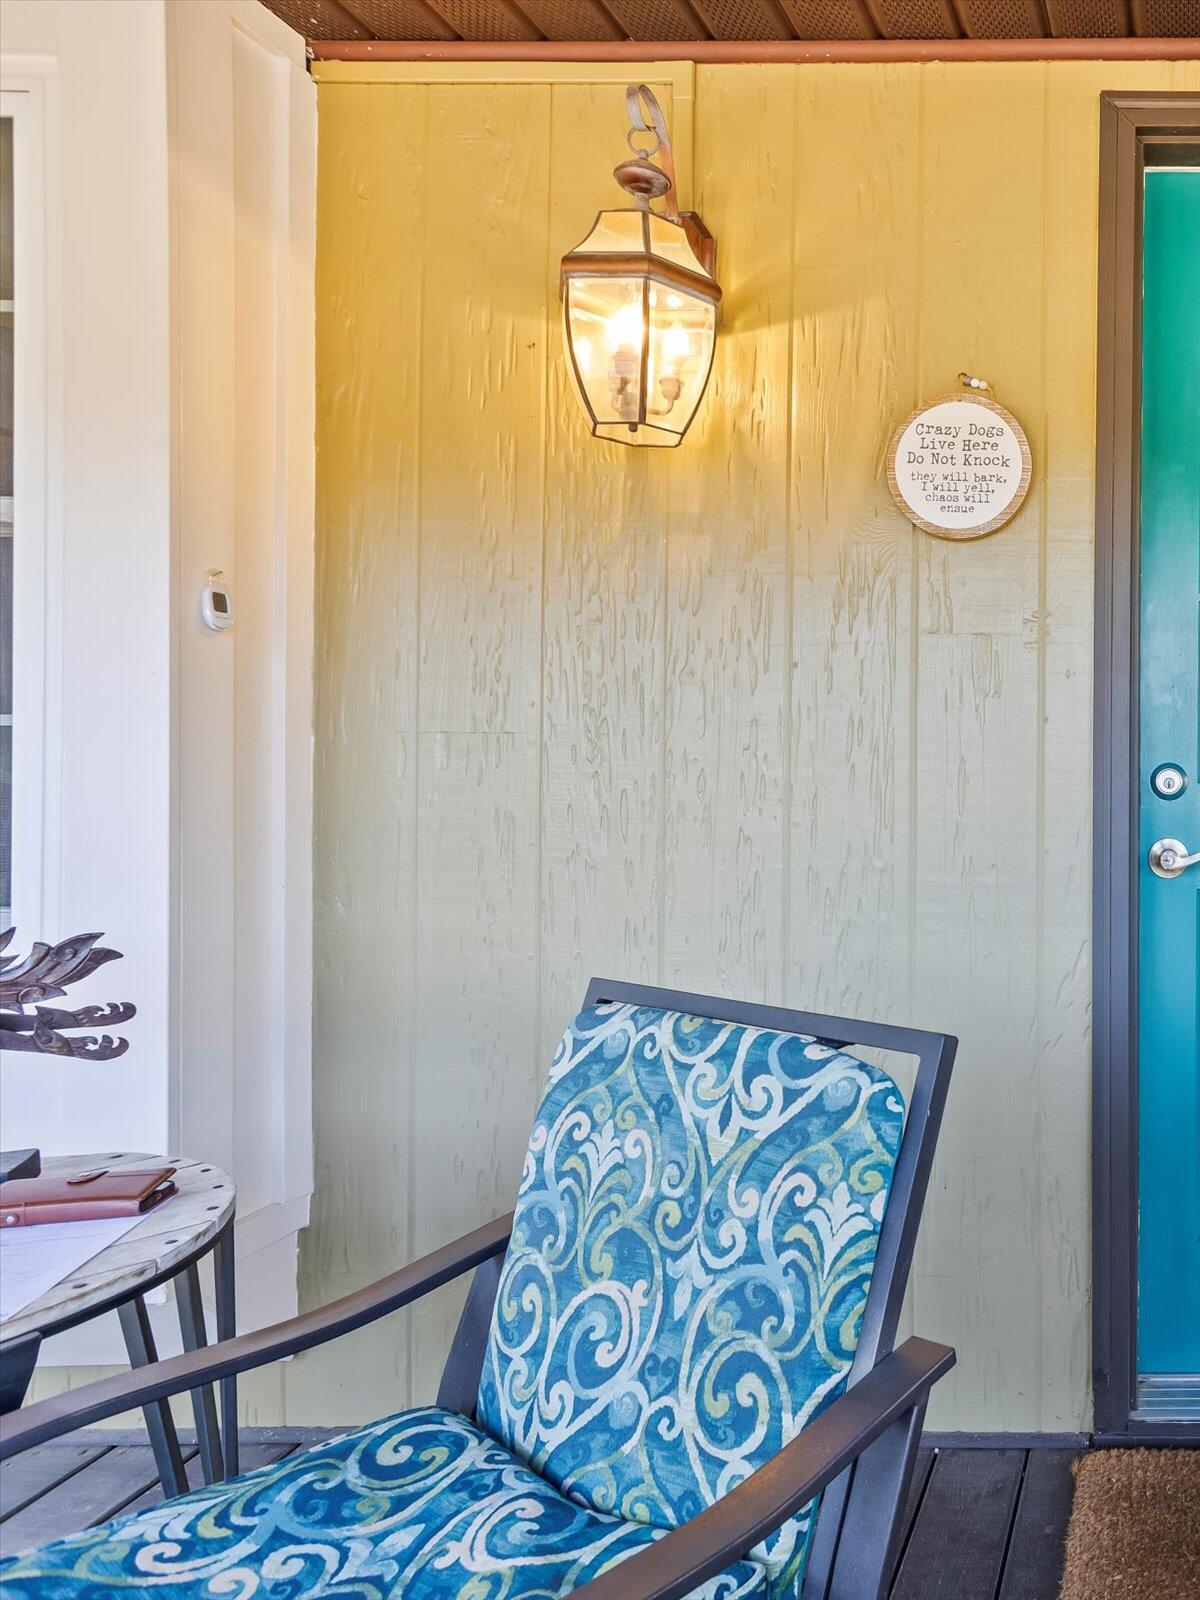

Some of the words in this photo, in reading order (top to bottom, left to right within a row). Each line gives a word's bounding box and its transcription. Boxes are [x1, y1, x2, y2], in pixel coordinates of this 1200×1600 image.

[915, 423, 962, 438] Crazy
[969, 423, 1004, 438] Dogs
[920, 437, 955, 450] Live
[962, 439, 998, 451] Here
[907, 451, 924, 464] Do
[931, 452, 956, 466] Not
[963, 453, 1010, 468] Knock
[911, 471, 937, 482] they
[942, 471, 968, 482] will
[974, 473, 1007, 484] bark,
[922, 481, 927, 491] I
[933, 482, 959, 492] will
[963, 483, 995, 494] yell,
[925, 492, 959, 502] chaos
[963, 494, 990, 503] will
[940, 504, 975, 513] ensue
